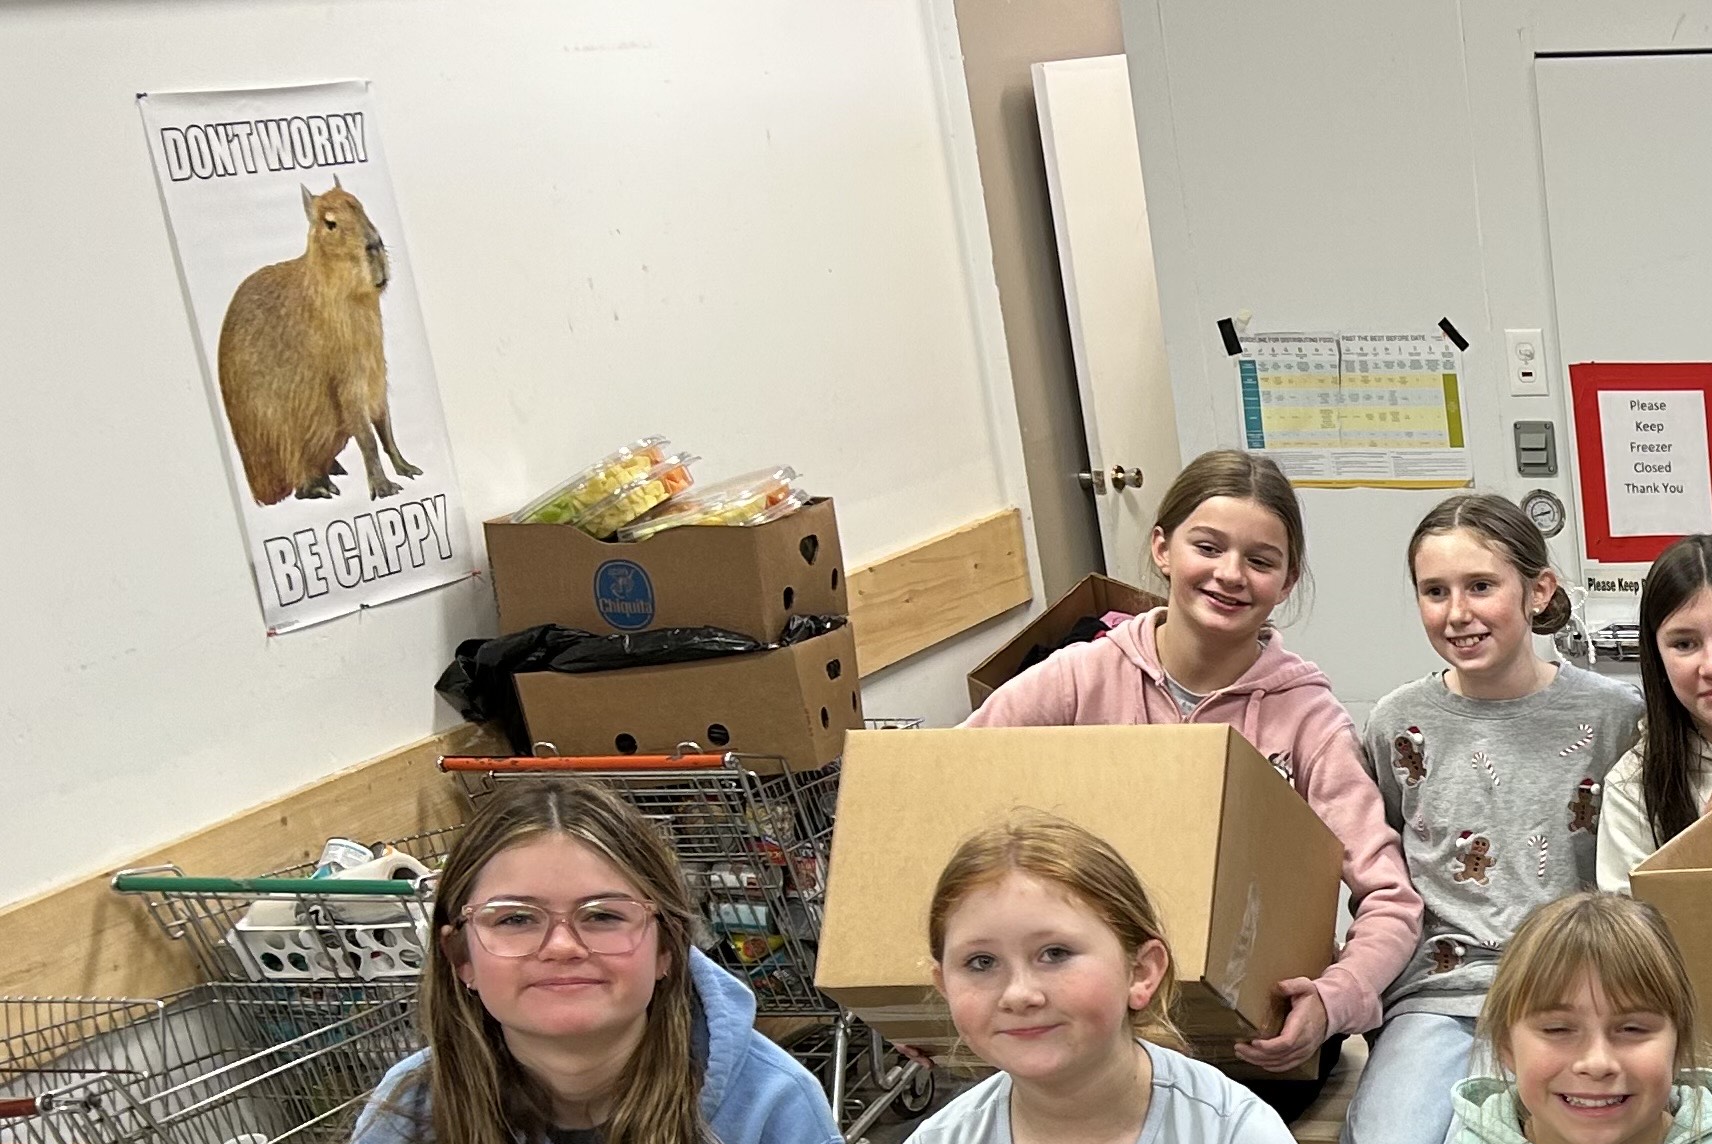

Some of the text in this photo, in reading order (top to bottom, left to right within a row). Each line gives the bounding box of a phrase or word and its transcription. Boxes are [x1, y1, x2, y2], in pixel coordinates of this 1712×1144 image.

[160, 111, 369, 182] DON'T WORRY
[1629, 400, 1667, 411] Please
[1635, 421, 1665, 433] Keep
[1630, 442, 1673, 453] Freezer
[1634, 462, 1672, 473] Closed
[1624, 483, 1684, 494] Thank You
[263, 494, 453, 608] BE CAPPY
[1587, 577, 1617, 592] Please
[1617, 577, 1640, 595] Keep
[600, 598, 653, 618] Chiquita
